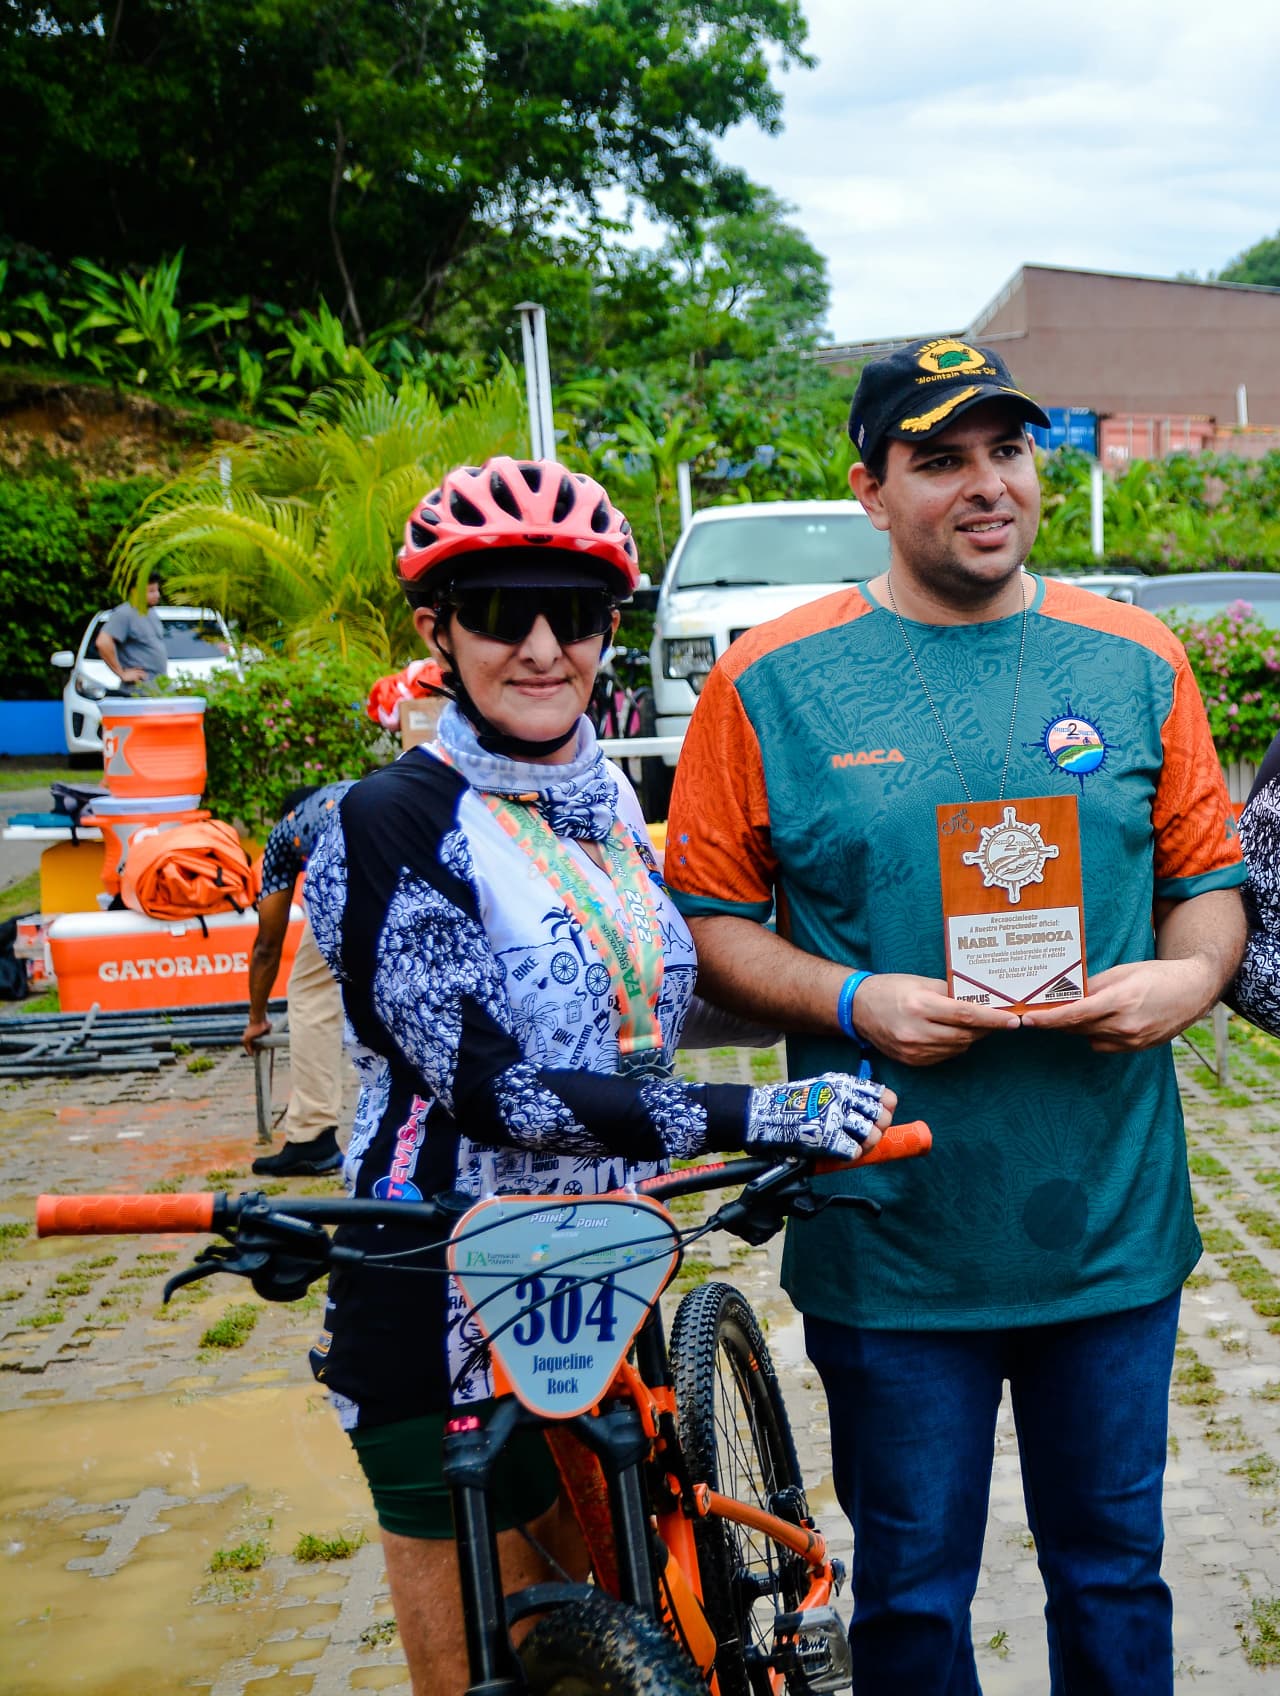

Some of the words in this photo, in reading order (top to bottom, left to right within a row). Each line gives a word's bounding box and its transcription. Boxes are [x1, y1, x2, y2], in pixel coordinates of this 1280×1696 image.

[1067, 723, 1080, 735] 2
[832, 749, 905, 768] MACA
[1006, 835, 1016, 847] 2
[624, 888, 652, 943] 2022
[957, 936, 999, 950] NABIL
[1005, 930, 1073, 946] ESPINOZA
[99, 951, 249, 983] GATORADE
[512, 955, 539, 981] BIKE
[622, 965, 641, 998] FA
[552, 1028, 577, 1047] BIKE
[569, 1024, 594, 1066] EXTREMO
[385, 1093, 431, 1200] TEVISAT
[640, 1161, 726, 1189] MOUNTAIN
[529, 1213, 565, 1225] POINT
[554, 1203, 578, 1231] 2
[576, 1217, 609, 1228] POINT
[512, 1274, 618, 1346] 304
[532, 1352, 594, 1375] Jaqueline
[547, 1377, 579, 1395] Rock
